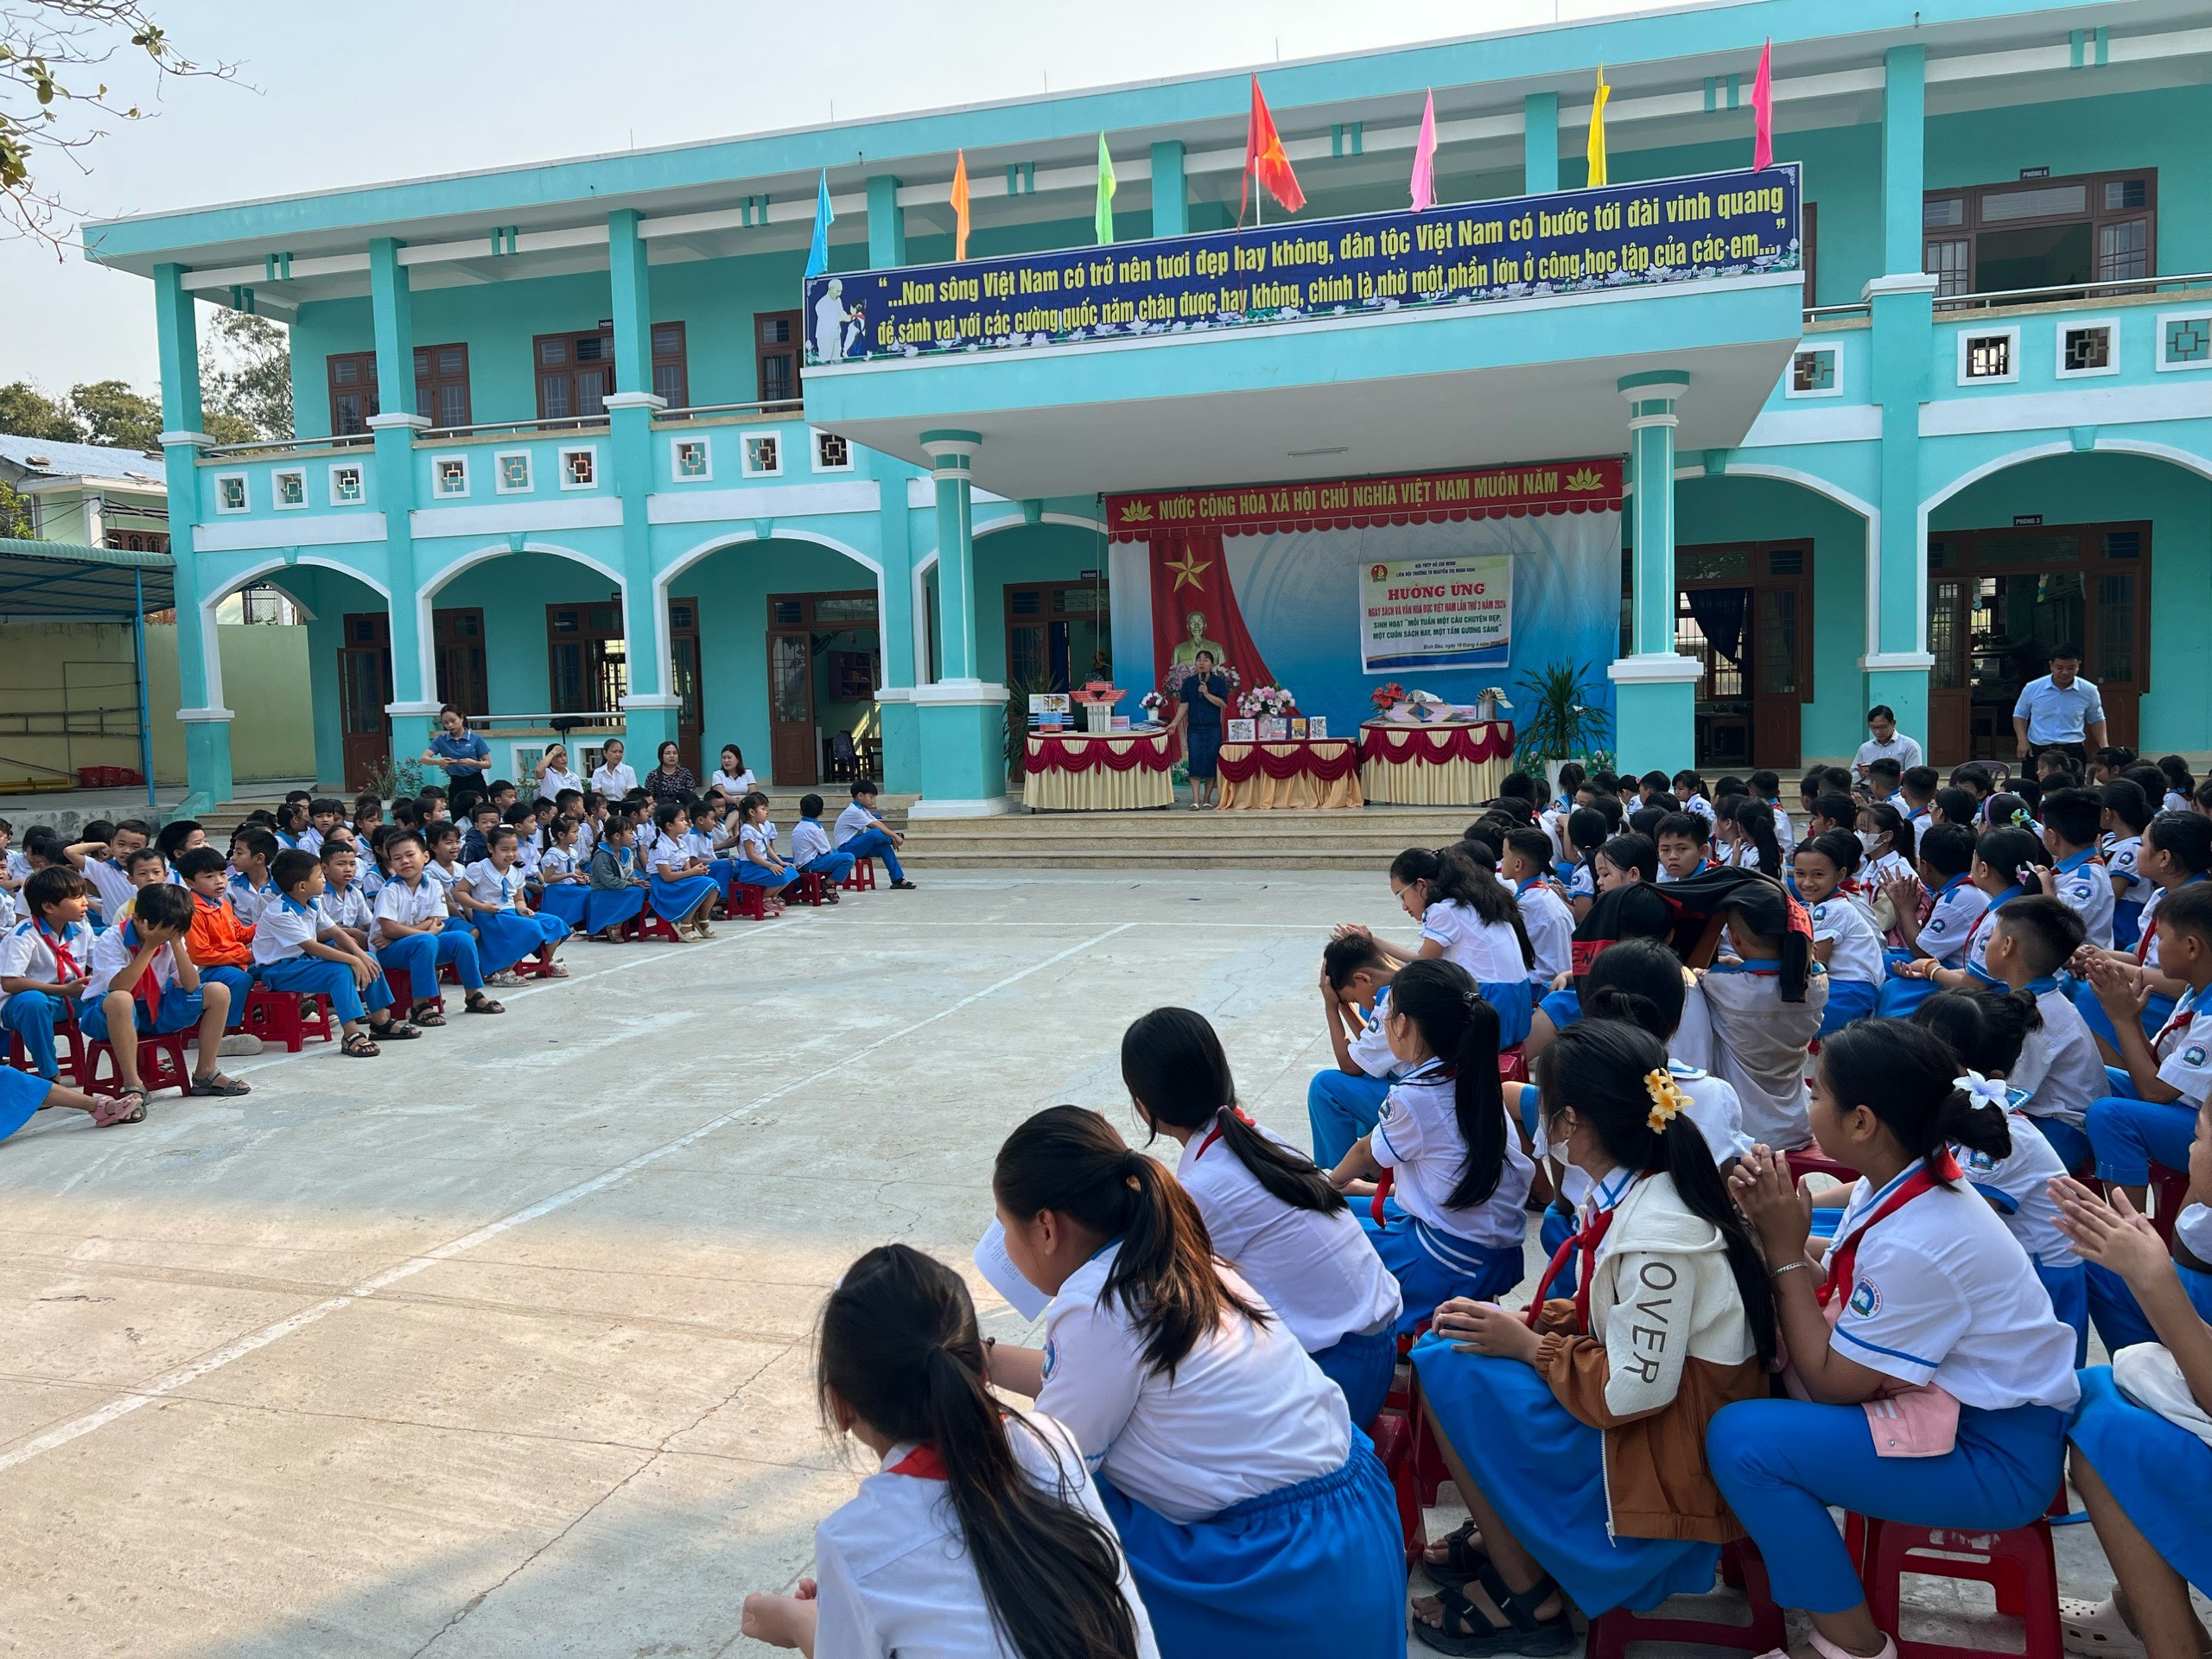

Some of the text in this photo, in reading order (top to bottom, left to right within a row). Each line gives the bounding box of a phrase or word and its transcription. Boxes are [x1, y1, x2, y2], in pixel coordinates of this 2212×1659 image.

[939, 276, 978, 302] sông
[983, 270, 1015, 301] Việt
[1020, 269, 1058, 294] Nam
[1064, 263, 1084, 289] có
[1090, 257, 1114, 286] trở
[1119, 257, 1151, 283] nên
[1156, 251, 1190, 279] tươi
[1196, 249, 1229, 279] đẹp
[1234, 245, 1266, 272] hay
[1271, 238, 1334, 267] không,
[1340, 231, 1375, 260] dân
[1381, 227, 1410, 260] tộc
[1415, 222, 1452, 255] Việt
[1458, 219, 1503, 247] Nam
[1509, 212, 1533, 241] có
[1539, 207, 1588, 238] bước
[1594, 202, 1620, 232] tới
[1627, 197, 1659, 228] đài
[1665, 192, 1711, 223] vinh
[1718, 187, 1783, 219] quang
[877, 315, 895, 346] để
[898, 311, 931, 343] sánh
[935, 315, 955, 340] vai
[959, 312, 981, 338] với
[984, 309, 1010, 335] các
[1014, 307, 1058, 333] cường
[1062, 297, 1097, 332] quốc
[1102, 297, 1135, 324] năm
[1138, 293, 1175, 321] châu
[1179, 290, 1217, 321] được
[1220, 287, 1248, 315] hay
[1252, 281, 1304, 309] không,
[1308, 275, 1352, 304] chính
[1357, 267, 1373, 299] là
[1376, 267, 1408, 296] nhờ
[1412, 264, 1444, 298] một
[1447, 256, 1488, 293] phần
[1493, 257, 1518, 285] lớn
[1523, 251, 1535, 283] ở
[1538, 251, 1580, 280] công
[1585, 248, 1617, 280] học
[1621, 242, 1649, 276] tập
[1654, 235, 1688, 269] của
[1692, 232, 1725, 264] các
[1159, 468, 1558, 521] NƯỚC CỘNG HÒA XÃ HỘI CHỦ NGHĨA VIỆT NAM MUÔN NĂM
[1388, 582, 1485, 601] HƯỞNG ỨNG
[1478, 601, 1481, 610] 3
[1389, 620, 1403, 629] HOẠT
[1437, 616, 1450, 626] MỘT
[1451, 615, 1463, 624] CÂU
[1464, 614, 1488, 624] CHUYỆN
[1373, 631, 1385, 640] MỘT
[1386, 629, 1402, 639] CUỐN
[1403, 629, 1420, 638] SÁCH
[1433, 627, 1446, 637] MỘT
[1447, 626, 1460, 635] TẤM
